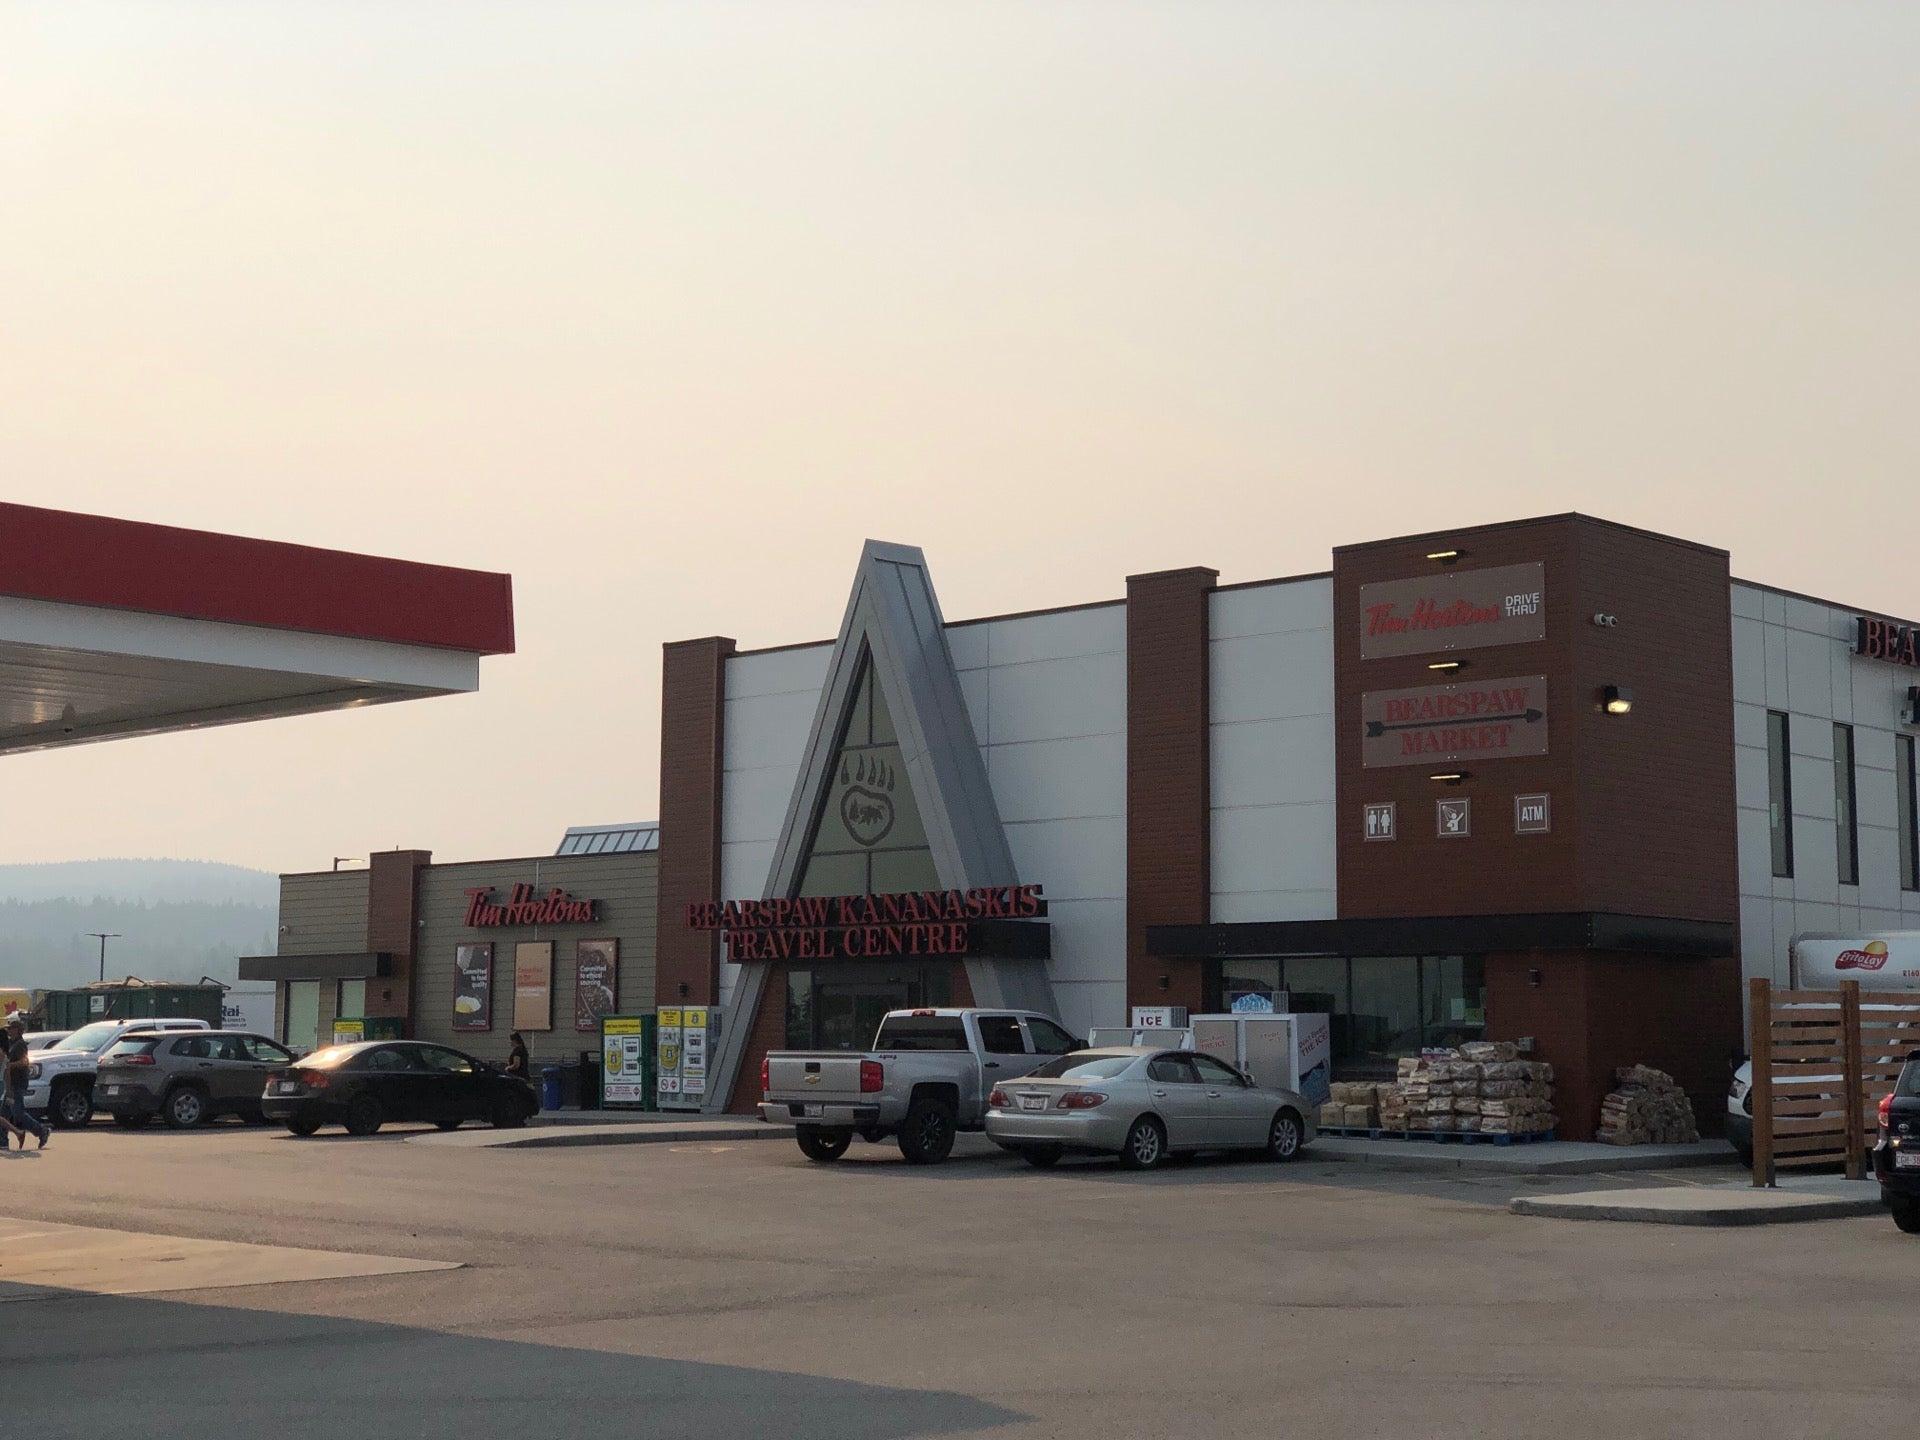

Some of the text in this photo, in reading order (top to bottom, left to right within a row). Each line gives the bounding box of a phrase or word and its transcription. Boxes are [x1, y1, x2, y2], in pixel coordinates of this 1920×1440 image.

[1505, 592, 1541, 607] DRIVE
[1505, 603, 1538, 617] THRU
[1366, 598, 1500, 638] Tim Hortons
[1384, 686, 1529, 722] BEARSPAW
[1400, 724, 1512, 755] MARKET
[1521, 805, 1544, 822] ATM
[464, 882, 594, 928] Tim Hortons
[684, 885, 1043, 930] BEARSPAW KANANASKIS
[723, 922, 969, 961] TRAVEL CENTRE
[580, 964, 607, 972] Committed
[580, 979, 601, 988] sourcing
[1140, 1016, 1163, 1026] ICE
